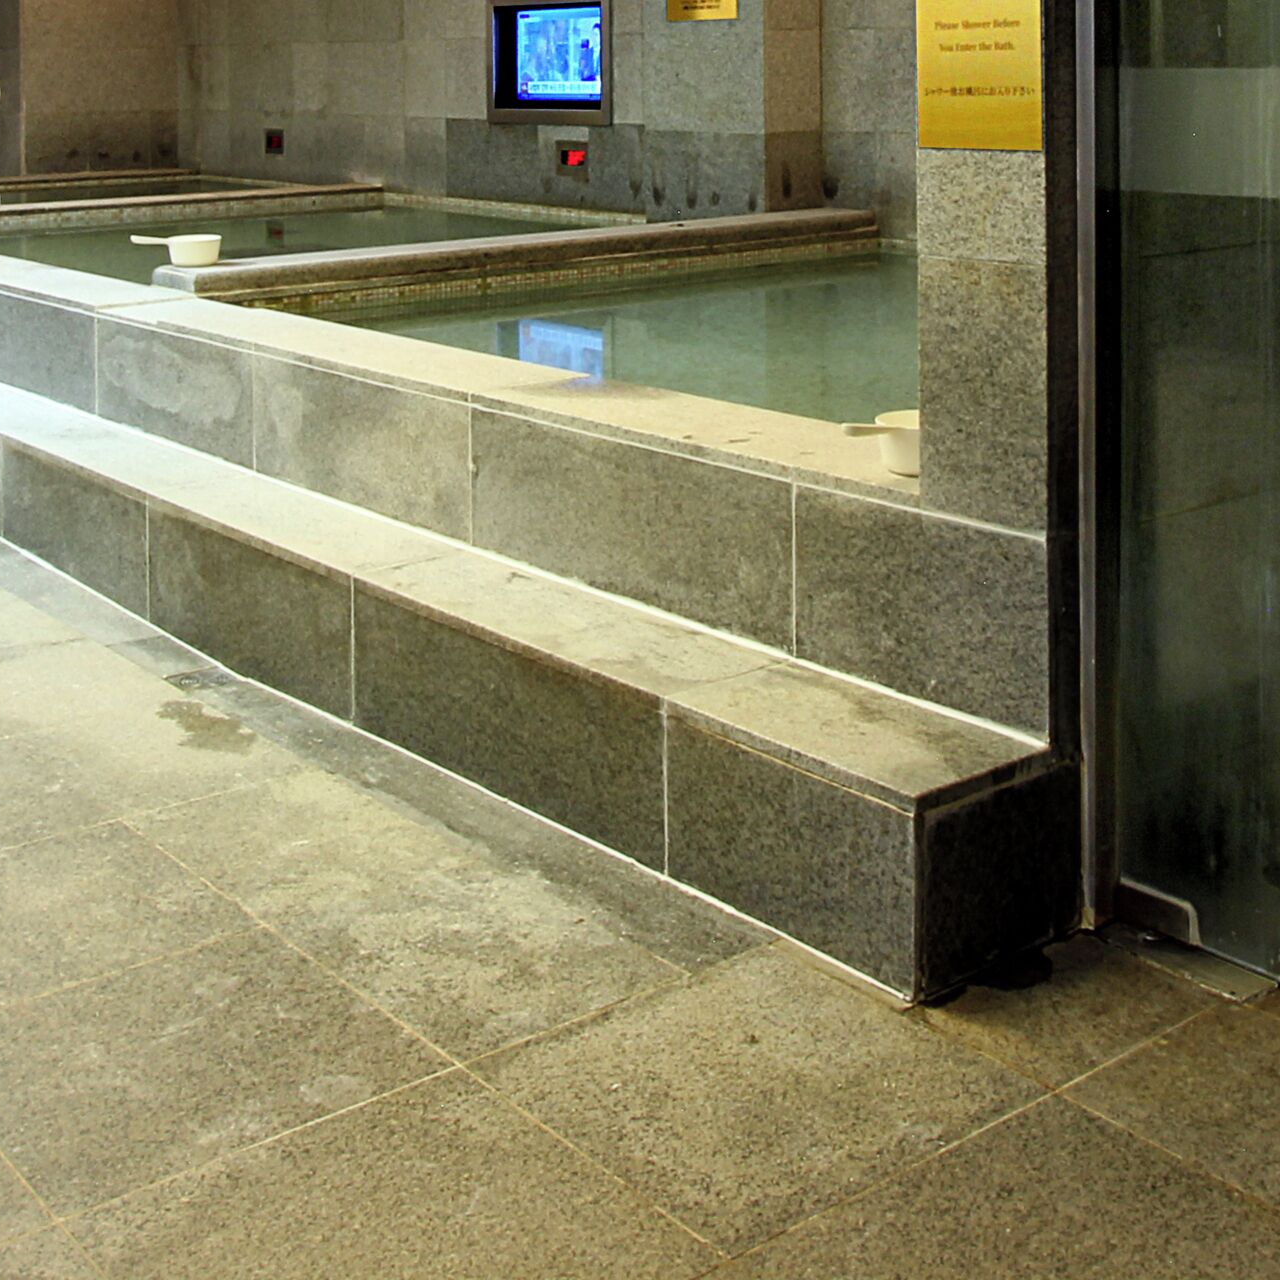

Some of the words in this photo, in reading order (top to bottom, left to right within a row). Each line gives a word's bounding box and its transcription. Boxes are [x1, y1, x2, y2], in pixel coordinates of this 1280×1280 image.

[961, 19, 991, 30] Shower
[993, 17, 1020, 29] Before
[955, 42, 977, 52] Enter
[978, 41, 993, 51] the
